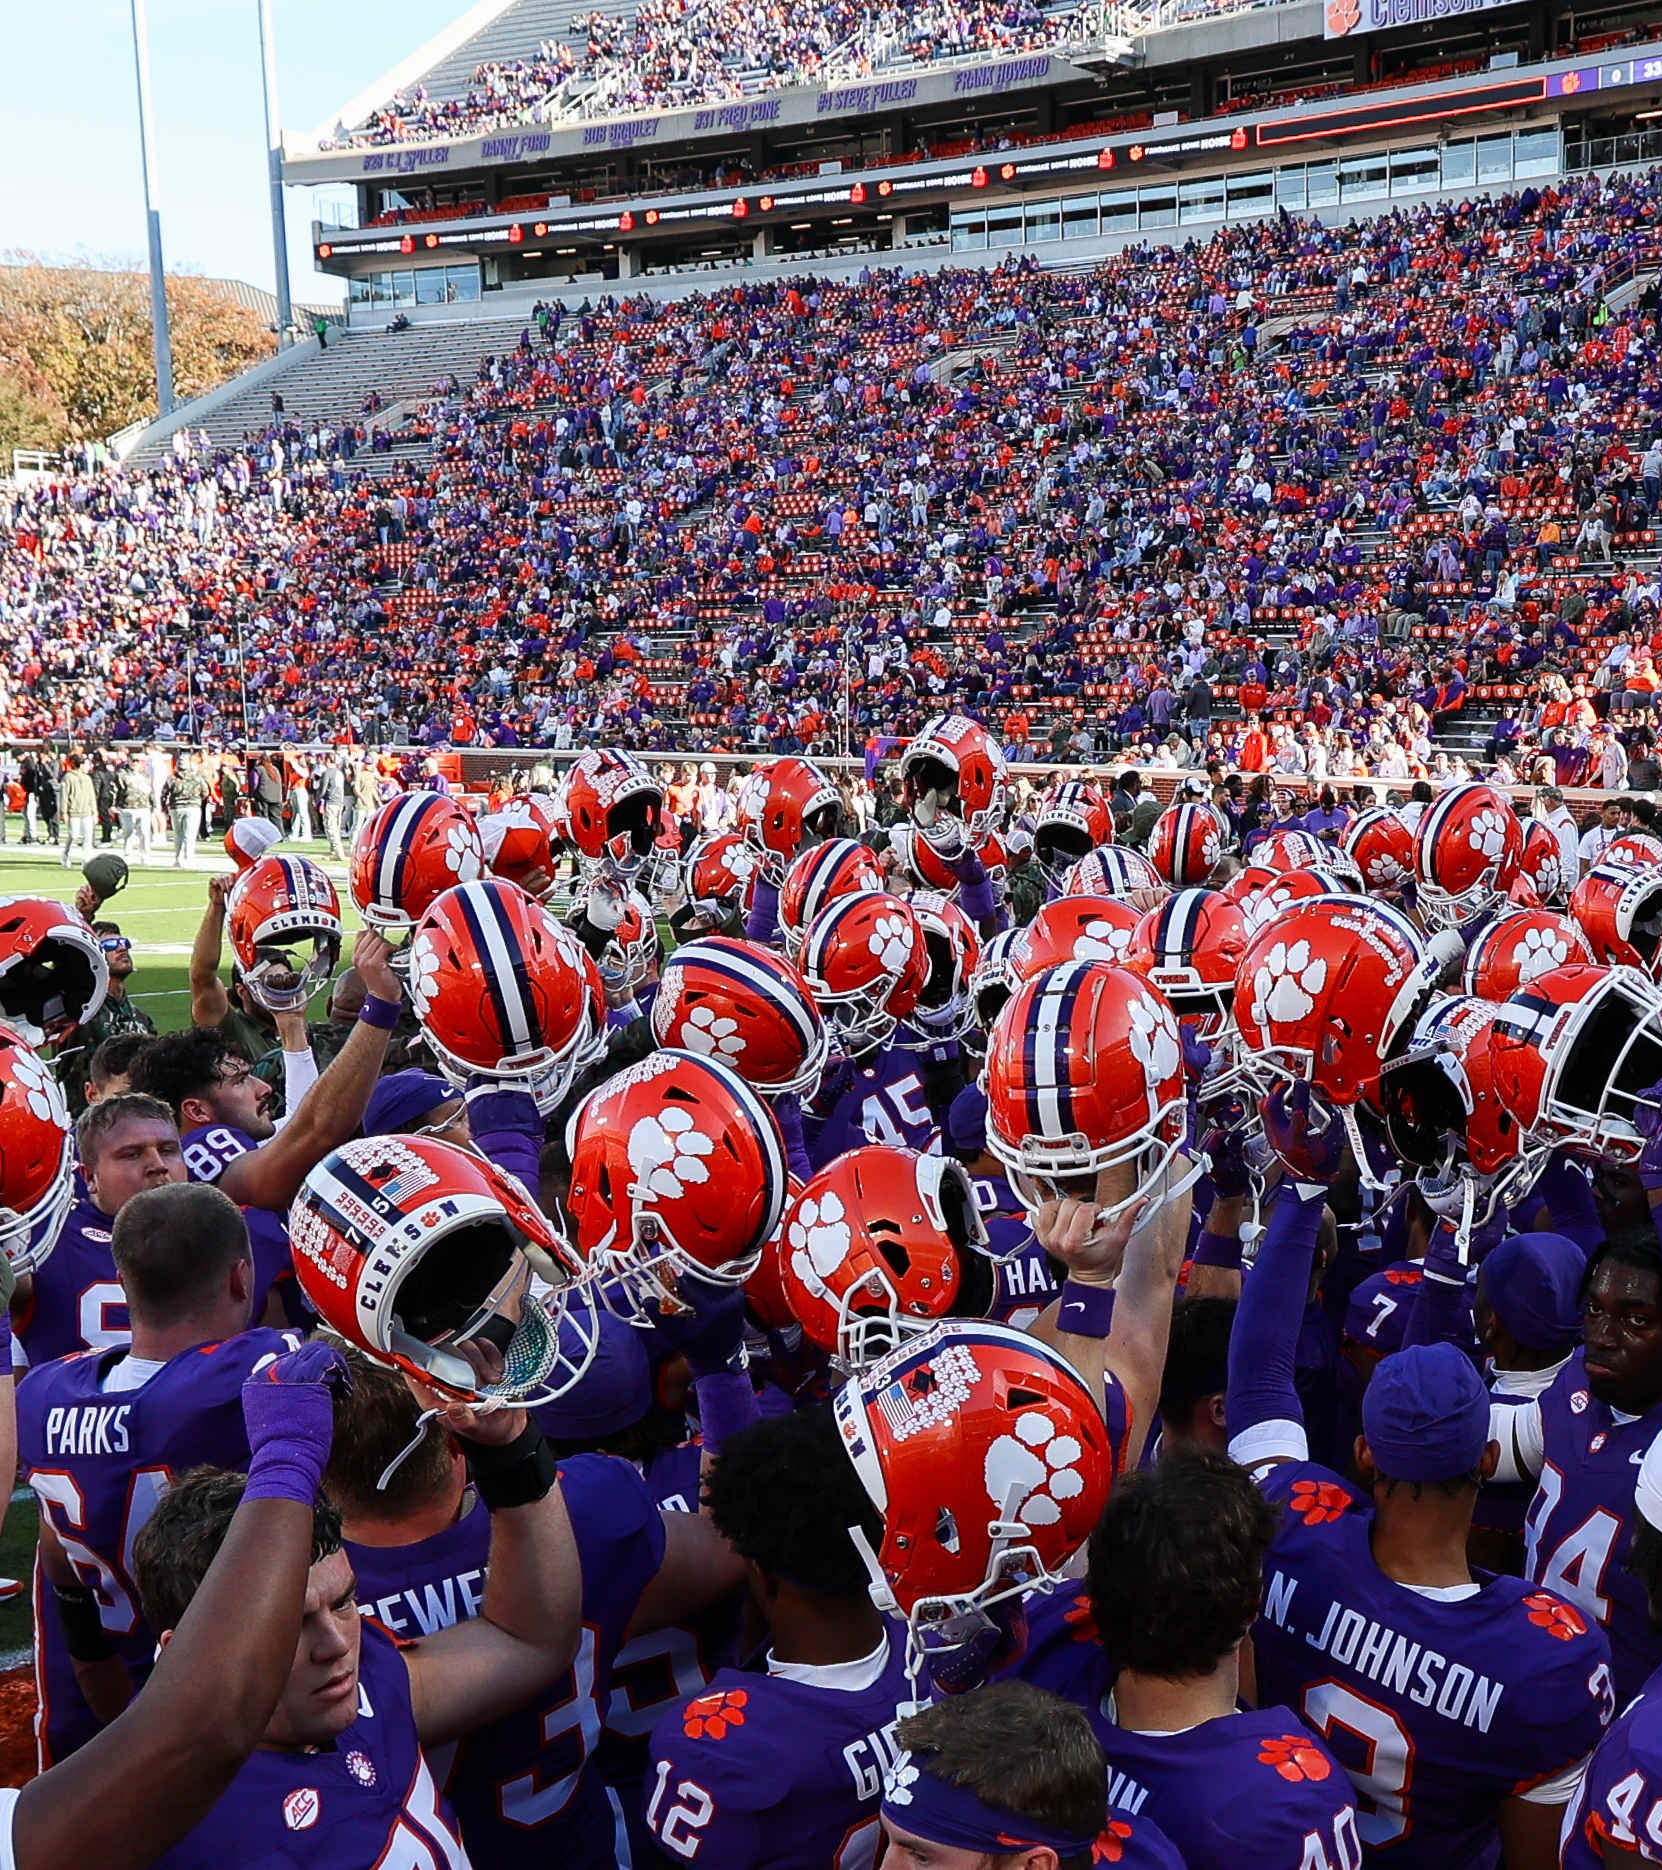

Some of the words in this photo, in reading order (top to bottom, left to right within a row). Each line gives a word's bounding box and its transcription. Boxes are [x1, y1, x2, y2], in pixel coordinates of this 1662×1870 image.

[953, 66, 993, 91] FRANK
[995, 55, 1050, 86] HOWARD
[1612, 67, 1621, 83] 0
[834, 88, 870, 110] STEVE
[871, 79, 917, 102] FULLER
[717, 106, 748, 127] FRED
[750, 100, 782, 122] CONE
[481, 138, 519, 158] DANNY
[520, 134, 551, 152] FORD
[583, 127, 607, 145] BOB
[609, 118, 660, 141] BRADLEY
[1200, 135, 1231, 150] NOISE
[406, 149, 450, 168] SPILLER
[1069, 155, 1099, 168] NOISE
[862, 1074, 932, 1147] 45
[184, 1128, 249, 1183] 89
[1366, 1293, 1398, 1338] 7
[47, 1404, 131, 1455] PARKS
[358, 1566, 491, 1637] EWE
[1265, 1570, 1297, 1634] N.
[1306, 1600, 1504, 1734] JOHNSON
[288, 1791, 316, 1824] ACC
[645, 1760, 714, 1859] 12
